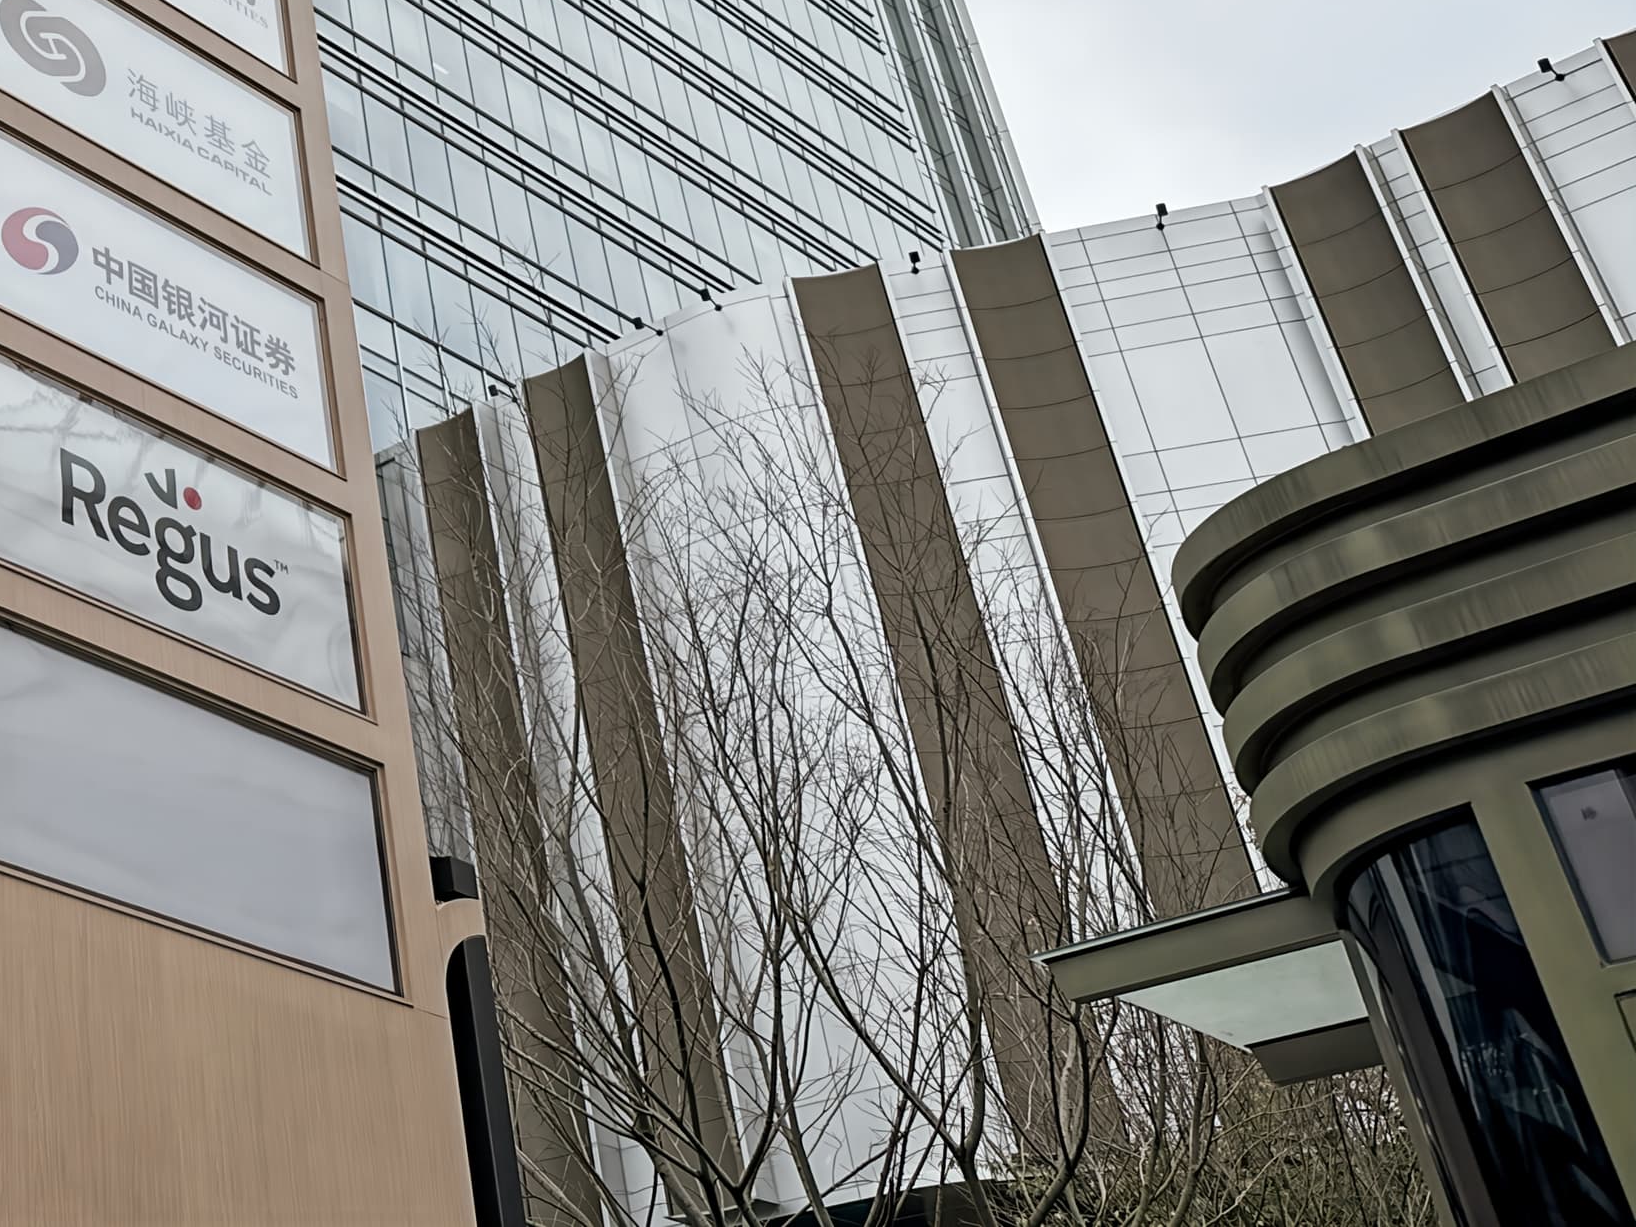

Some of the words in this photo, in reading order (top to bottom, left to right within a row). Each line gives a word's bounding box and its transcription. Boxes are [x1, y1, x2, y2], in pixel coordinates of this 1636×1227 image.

[127, 68, 271, 178] 海峡基金
[130, 106, 195, 154] HAIXIA
[197, 146, 272, 196] CAPITAL
[92, 246, 296, 376] 中国银河证券
[95, 285, 143, 321] CHINA
[147, 314, 208, 353] GALAXY
[214, 344, 299, 399] SECURITIES
[60, 447, 281, 616] Regus
